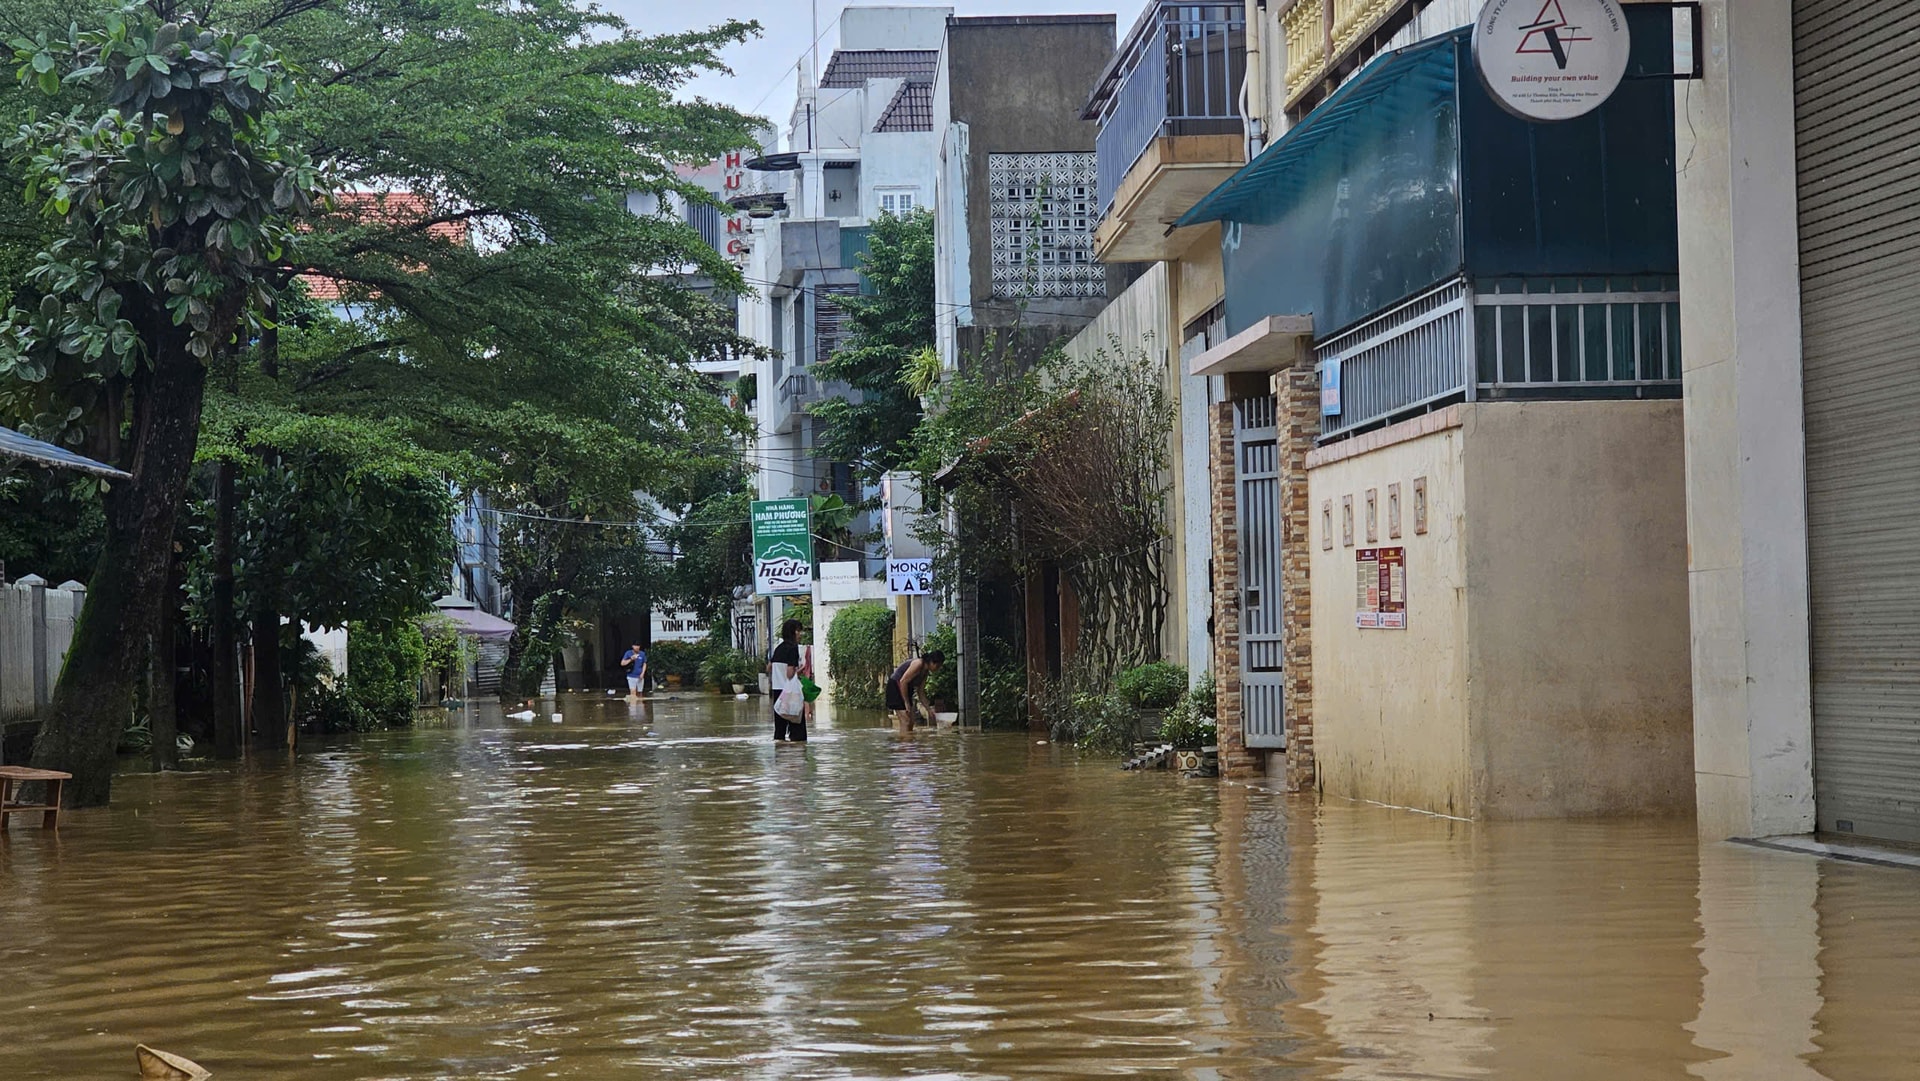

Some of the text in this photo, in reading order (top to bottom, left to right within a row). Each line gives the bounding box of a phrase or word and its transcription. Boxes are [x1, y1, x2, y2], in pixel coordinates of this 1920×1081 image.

[1511, 75, 1543, 83] Building
[1544, 75, 1561, 83] your
[779, 503, 795, 511] HÀNG
[755, 510, 806, 521] NAM PHƯƠNG
[759, 559, 810, 578] huda
[891, 577, 929, 592] LAB
[661, 619, 684, 632] VINH
